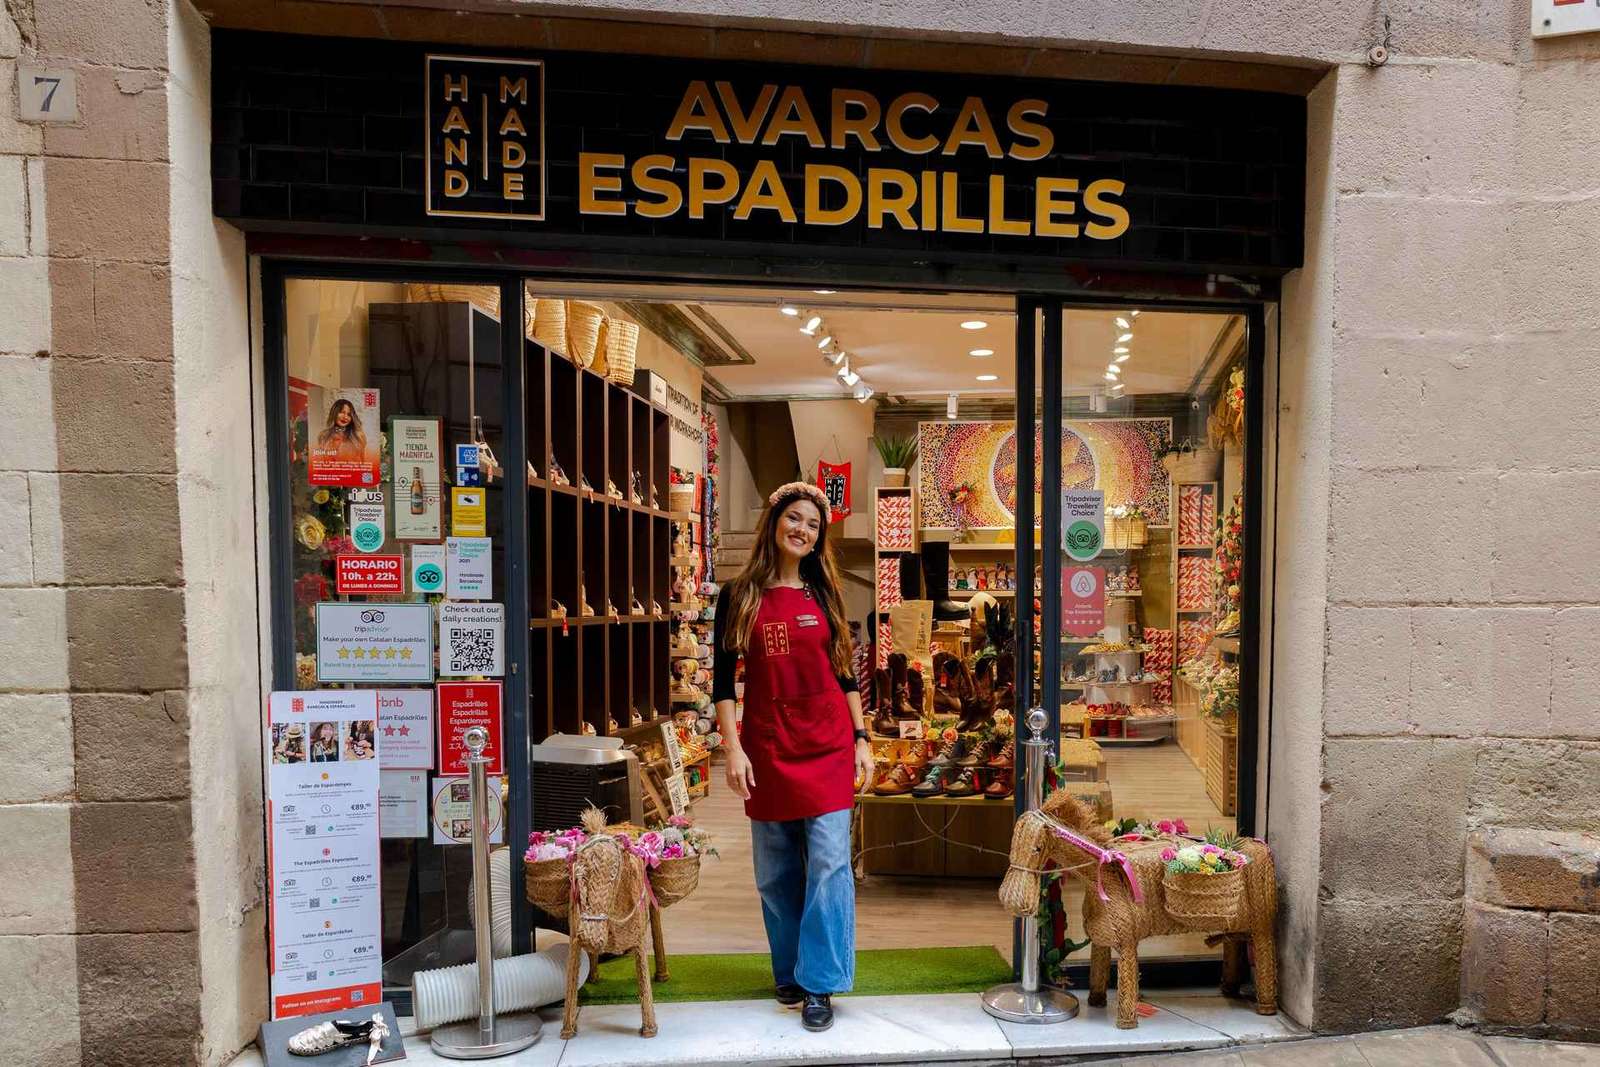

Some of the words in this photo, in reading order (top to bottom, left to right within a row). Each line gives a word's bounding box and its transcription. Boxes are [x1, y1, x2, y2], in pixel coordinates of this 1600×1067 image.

[34, 76, 61, 112] 7
[665, 79, 1055, 161] AVARCAS
[442, 74, 471, 198] HAND
[499, 76, 528, 201] MADE
[578, 151, 1131, 241] ESPADRILLES
[405, 443, 429, 451] TIENDA
[1066, 502, 1100, 510] Travellers'
[1071, 509, 1095, 517] Choice
[342, 560, 398, 569] HORARIO
[342, 572, 364, 580] 10h.
[375, 572, 398, 580] 22h.
[445, 605, 470, 613] Check
[442, 615, 461, 624] daily
[463, 615, 503, 623] creations!
[766, 626, 774, 654] HAND
[778, 624, 786, 653] MADE
[394, 714, 428, 722] Espadrilles
[449, 717, 491, 725] Espardenyes
